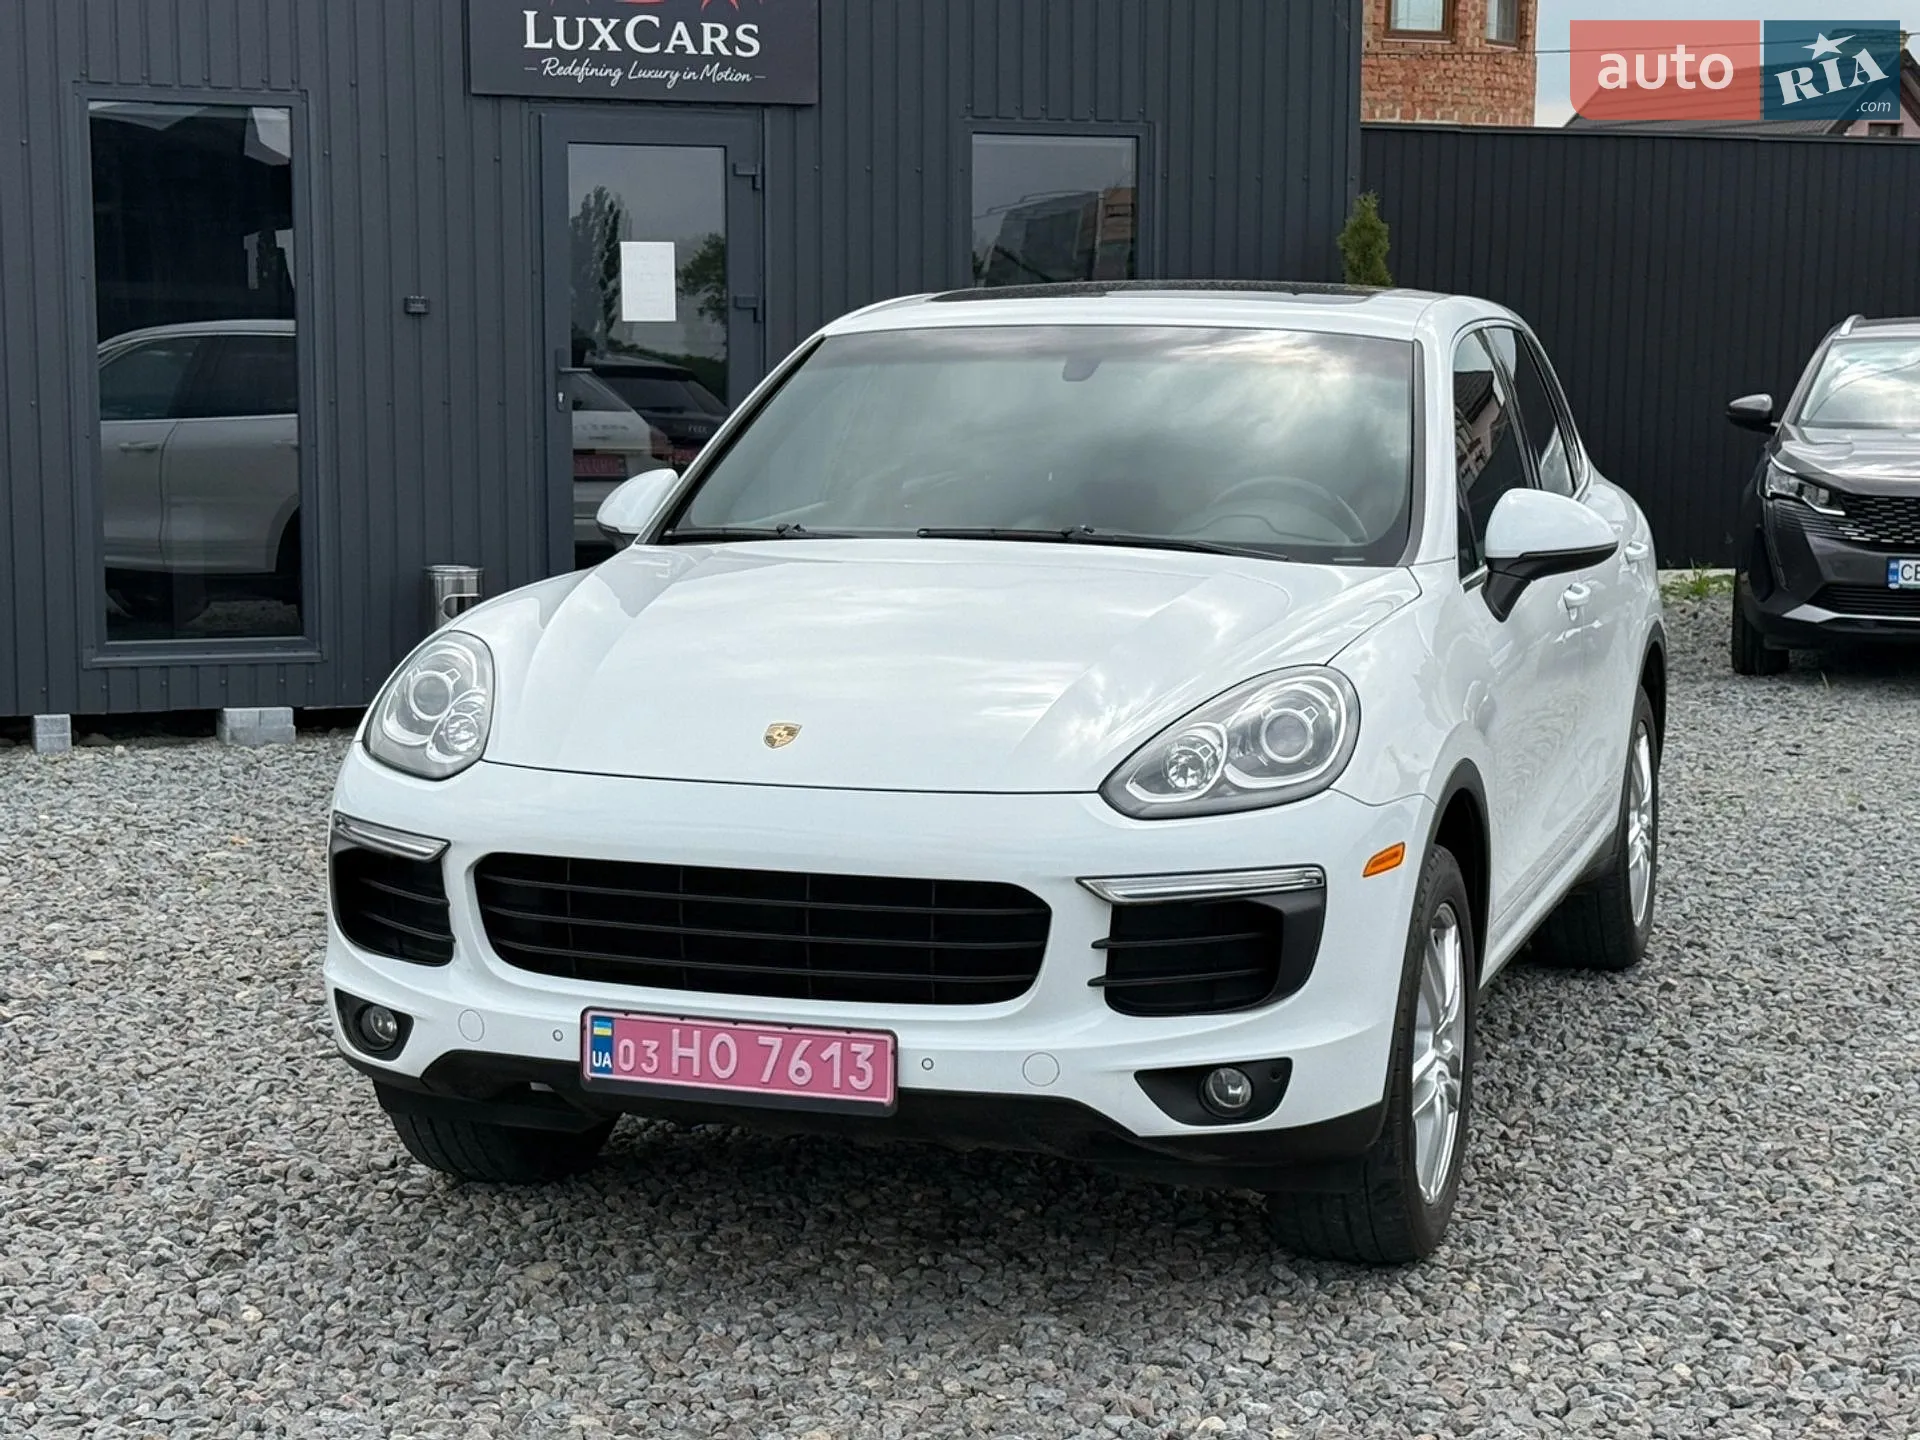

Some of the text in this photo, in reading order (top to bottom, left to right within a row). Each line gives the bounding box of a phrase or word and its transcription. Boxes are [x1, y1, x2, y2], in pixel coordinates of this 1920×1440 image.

[541, 57, 752, 89] Redefining Luxury in Motion
[592, 1050, 612, 1069] UA
[618, 1028, 874, 1091] 03 HO 7613
